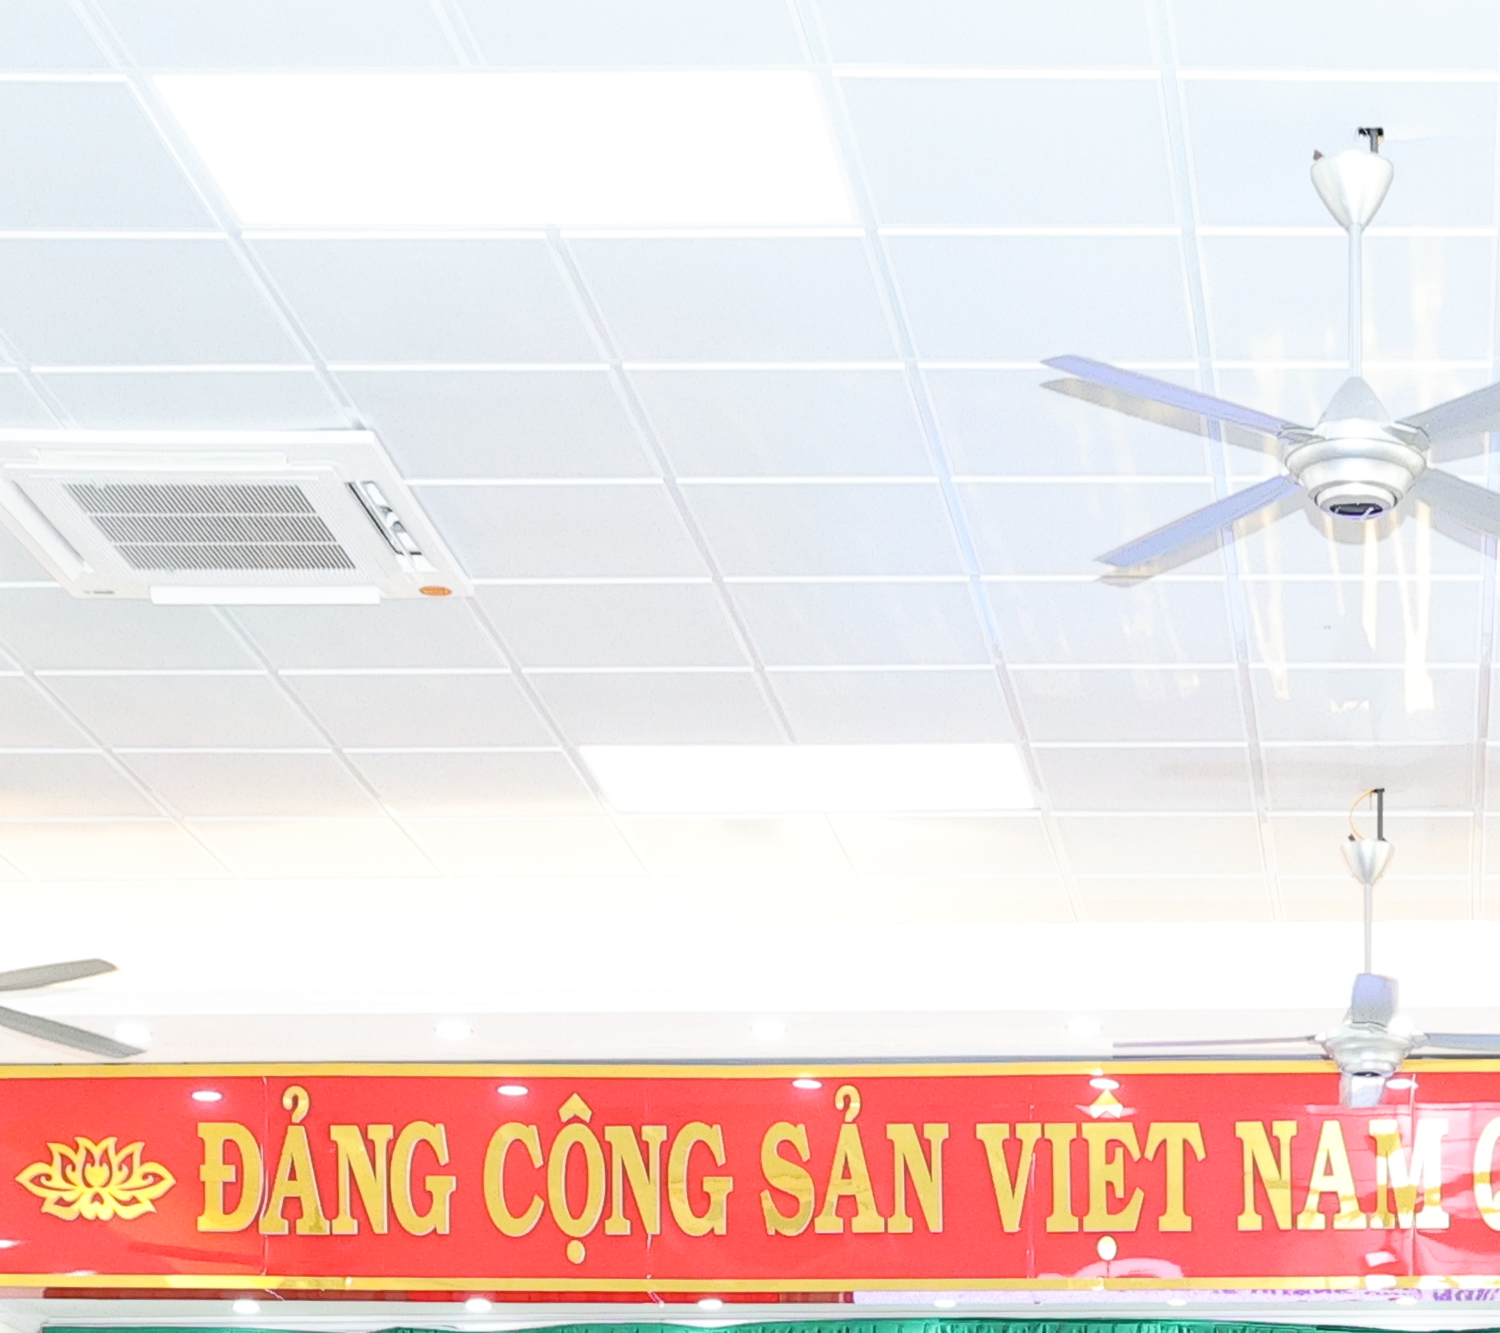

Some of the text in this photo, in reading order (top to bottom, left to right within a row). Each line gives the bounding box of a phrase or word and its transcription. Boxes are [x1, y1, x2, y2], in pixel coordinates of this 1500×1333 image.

[197, 1086, 453, 1234] ĐẢNG
[484, 1095, 732, 1262] CỘNG
[760, 1085, 948, 1236] SẢN
[976, 1089, 1206, 1262] VIỆT
[1235, 1121, 1441, 1231] NAM
